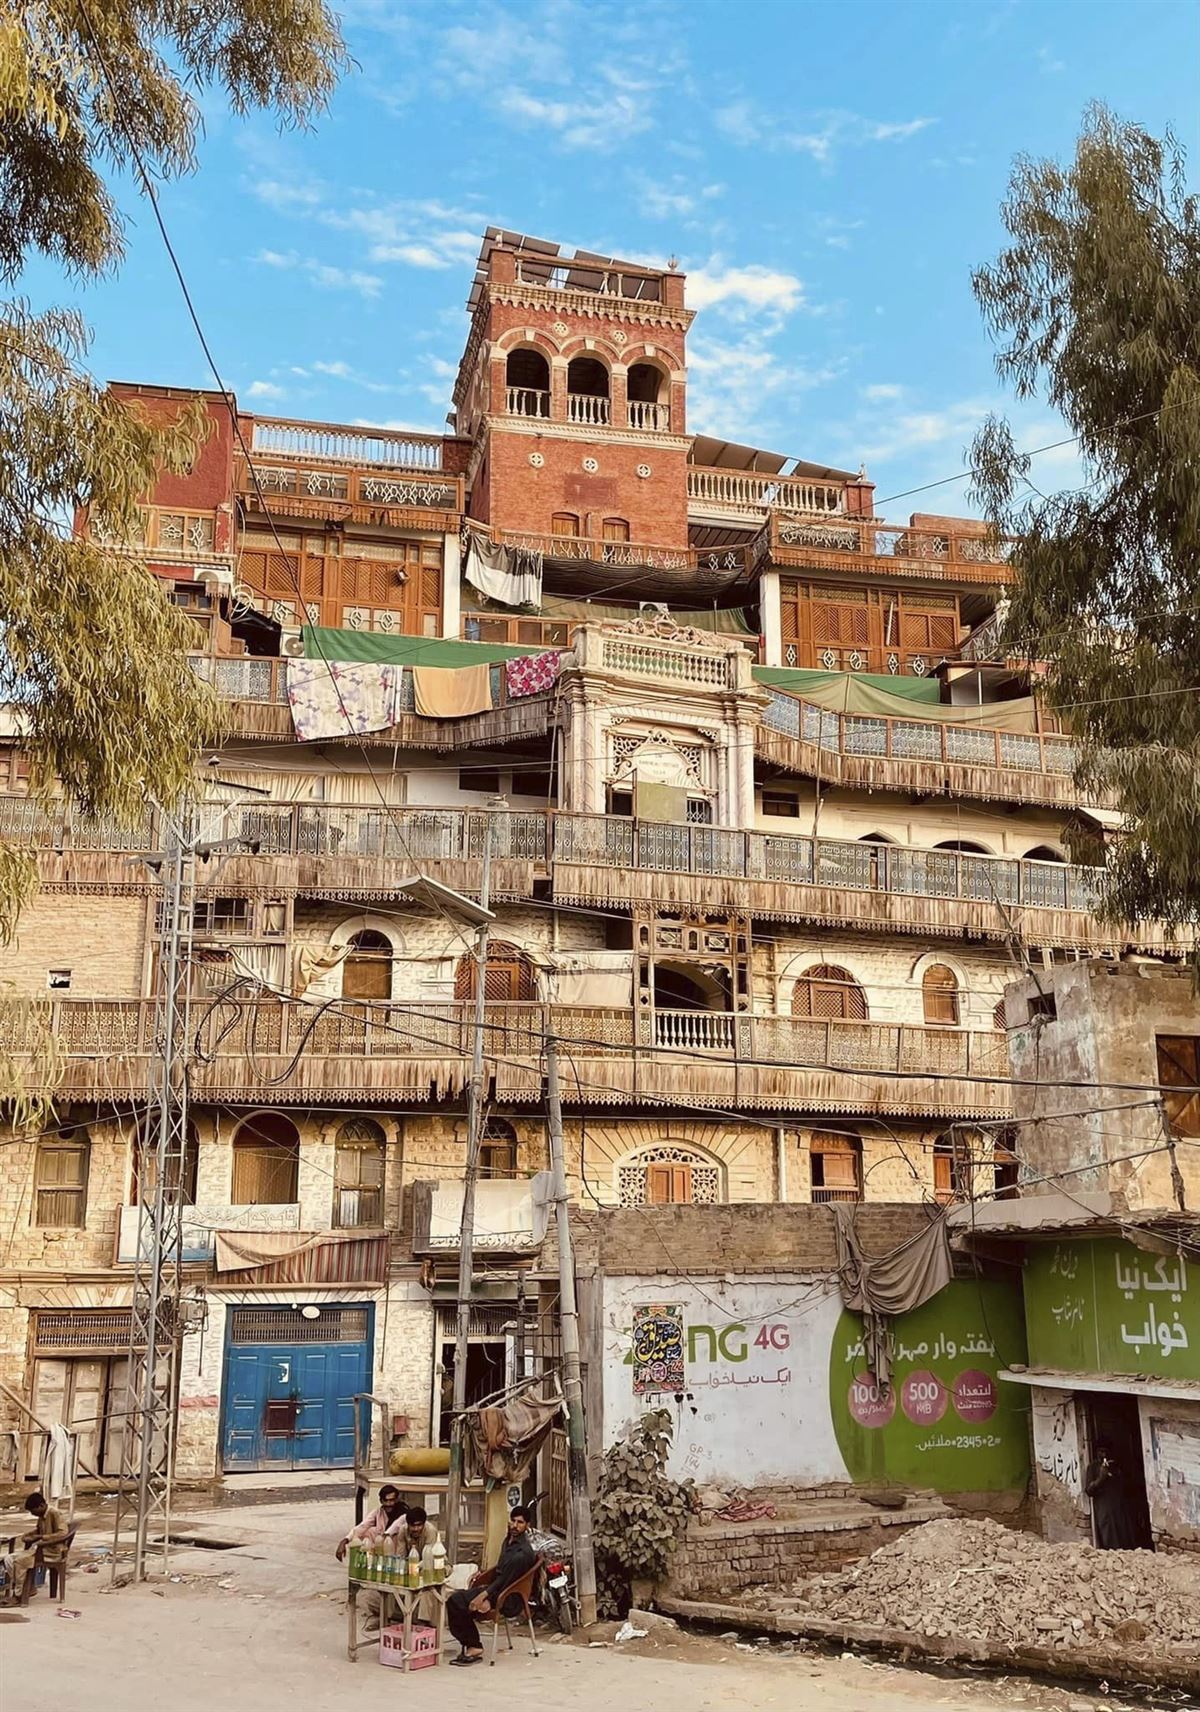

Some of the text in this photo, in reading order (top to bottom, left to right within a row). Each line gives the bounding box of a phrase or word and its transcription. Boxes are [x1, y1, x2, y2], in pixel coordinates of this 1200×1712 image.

[1115, 1252, 1188, 1302] ایک نیا
[754, 1324, 790, 1350] 4G
[1121, 1303, 1189, 1357] خواب
[932, 1332, 957, 1360] وار
[689, 1371, 732, 1388] خواب
[761, 1367, 791, 1387] ایک
[909, 1383, 938, 1400] 500
[916, 1403, 932, 1415] MB
